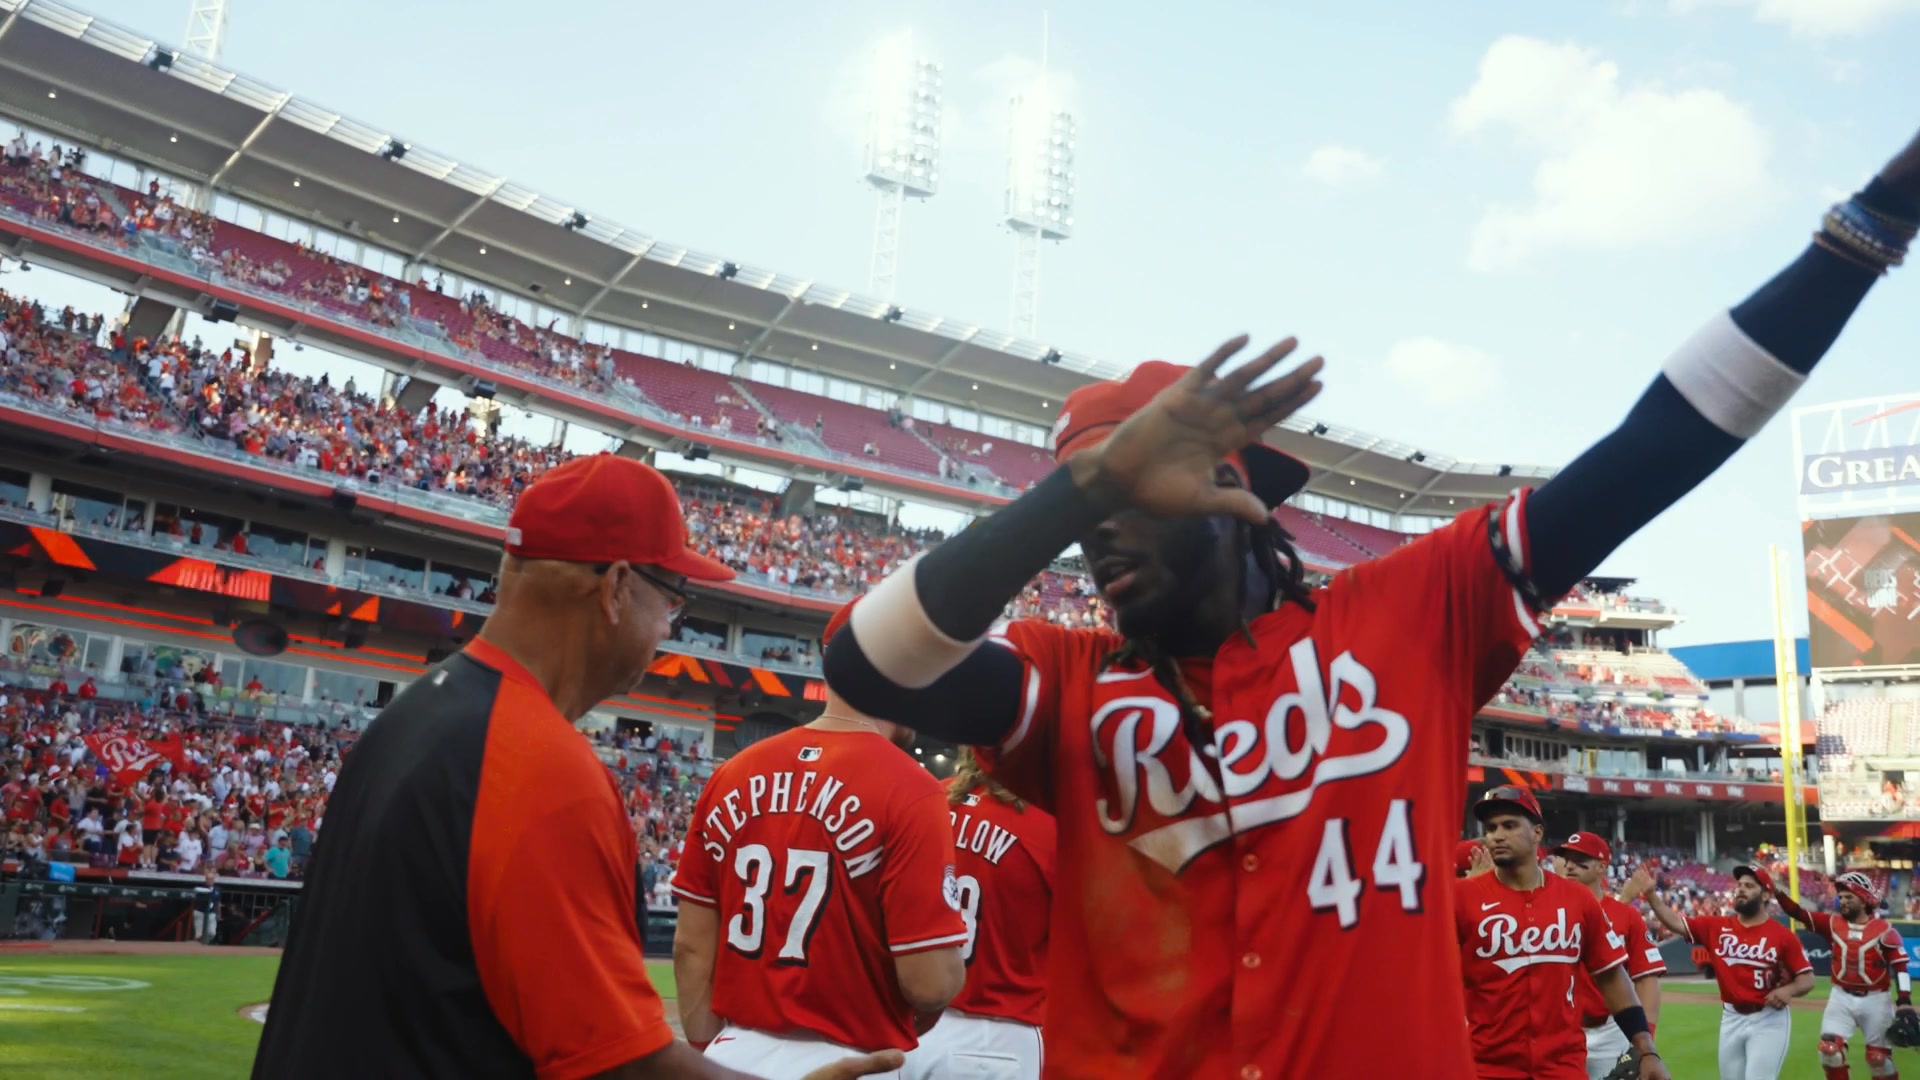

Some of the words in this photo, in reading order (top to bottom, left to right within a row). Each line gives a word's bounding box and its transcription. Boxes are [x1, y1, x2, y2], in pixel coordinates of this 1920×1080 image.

[1091, 636, 1411, 874] Reds
[703, 770, 885, 879] STEPHENSON
[1307, 798, 1424, 928] 44
[726, 843, 832, 967] 37
[1476, 907, 1581, 974] Reds
[1715, 934, 1777, 967] Reds
